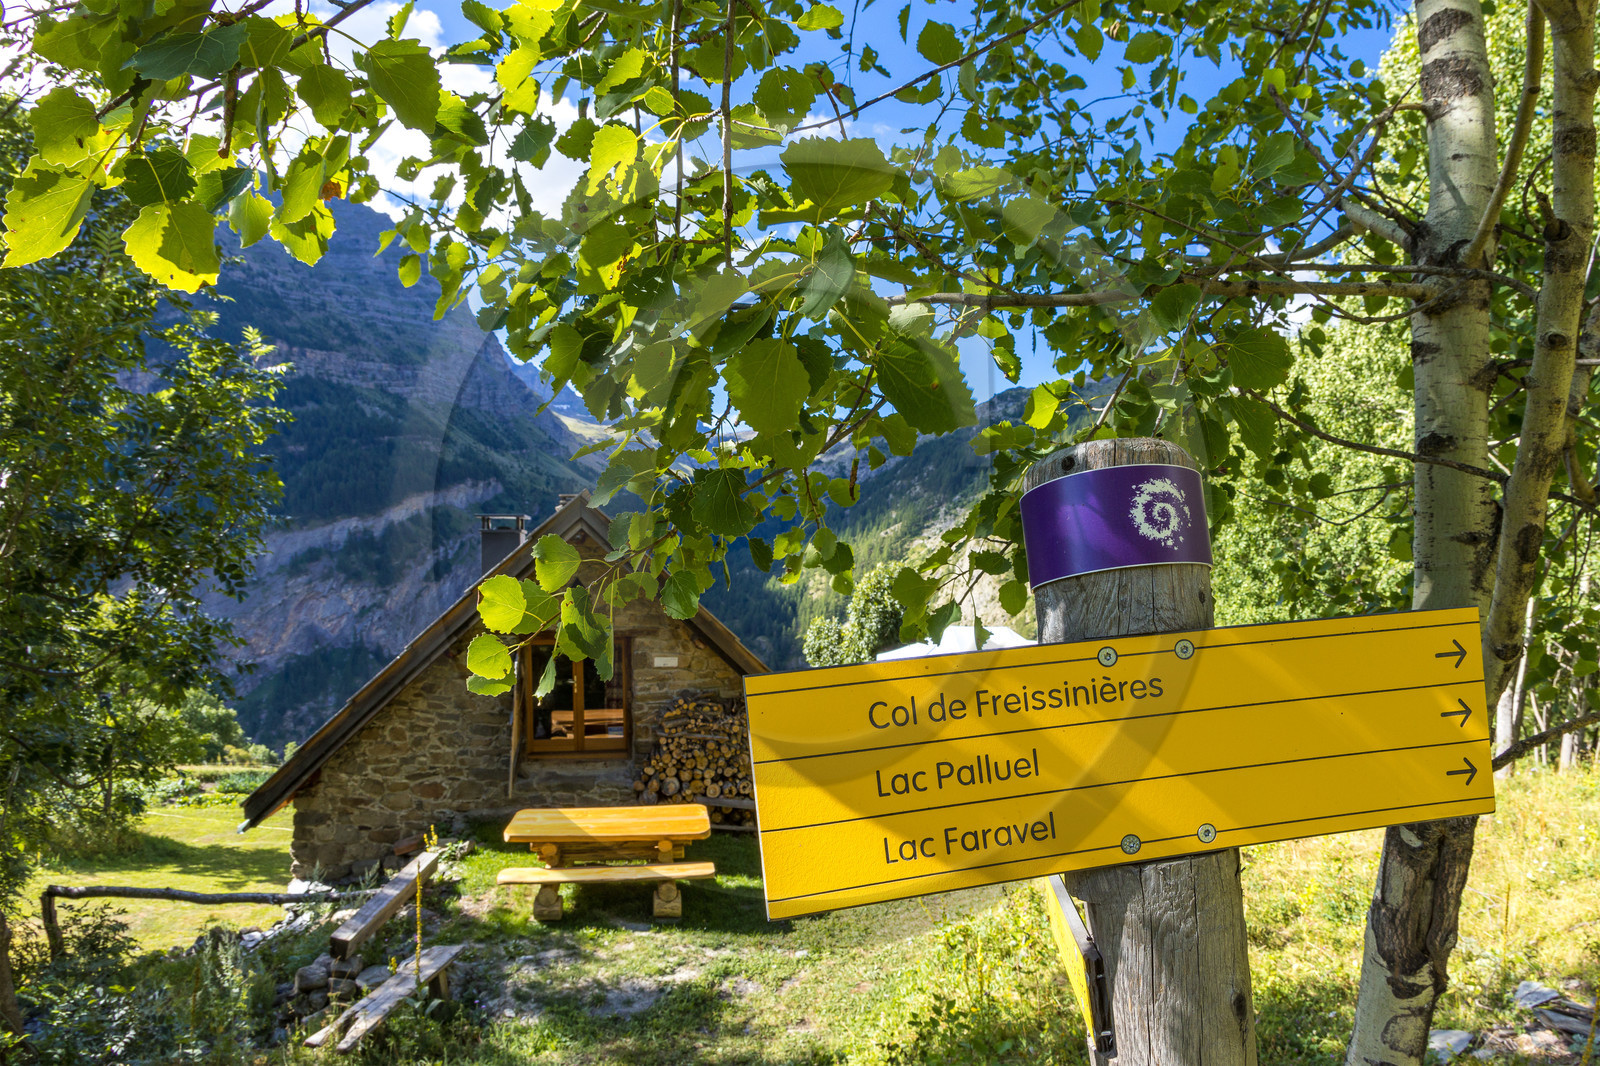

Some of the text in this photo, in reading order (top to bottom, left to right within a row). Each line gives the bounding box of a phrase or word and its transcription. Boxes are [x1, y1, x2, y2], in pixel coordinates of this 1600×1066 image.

[868, 676, 1164, 729] Col de Freissinières
[875, 748, 1040, 798] Lac Palluel
[883, 811, 1056, 865] Lac Faravel
